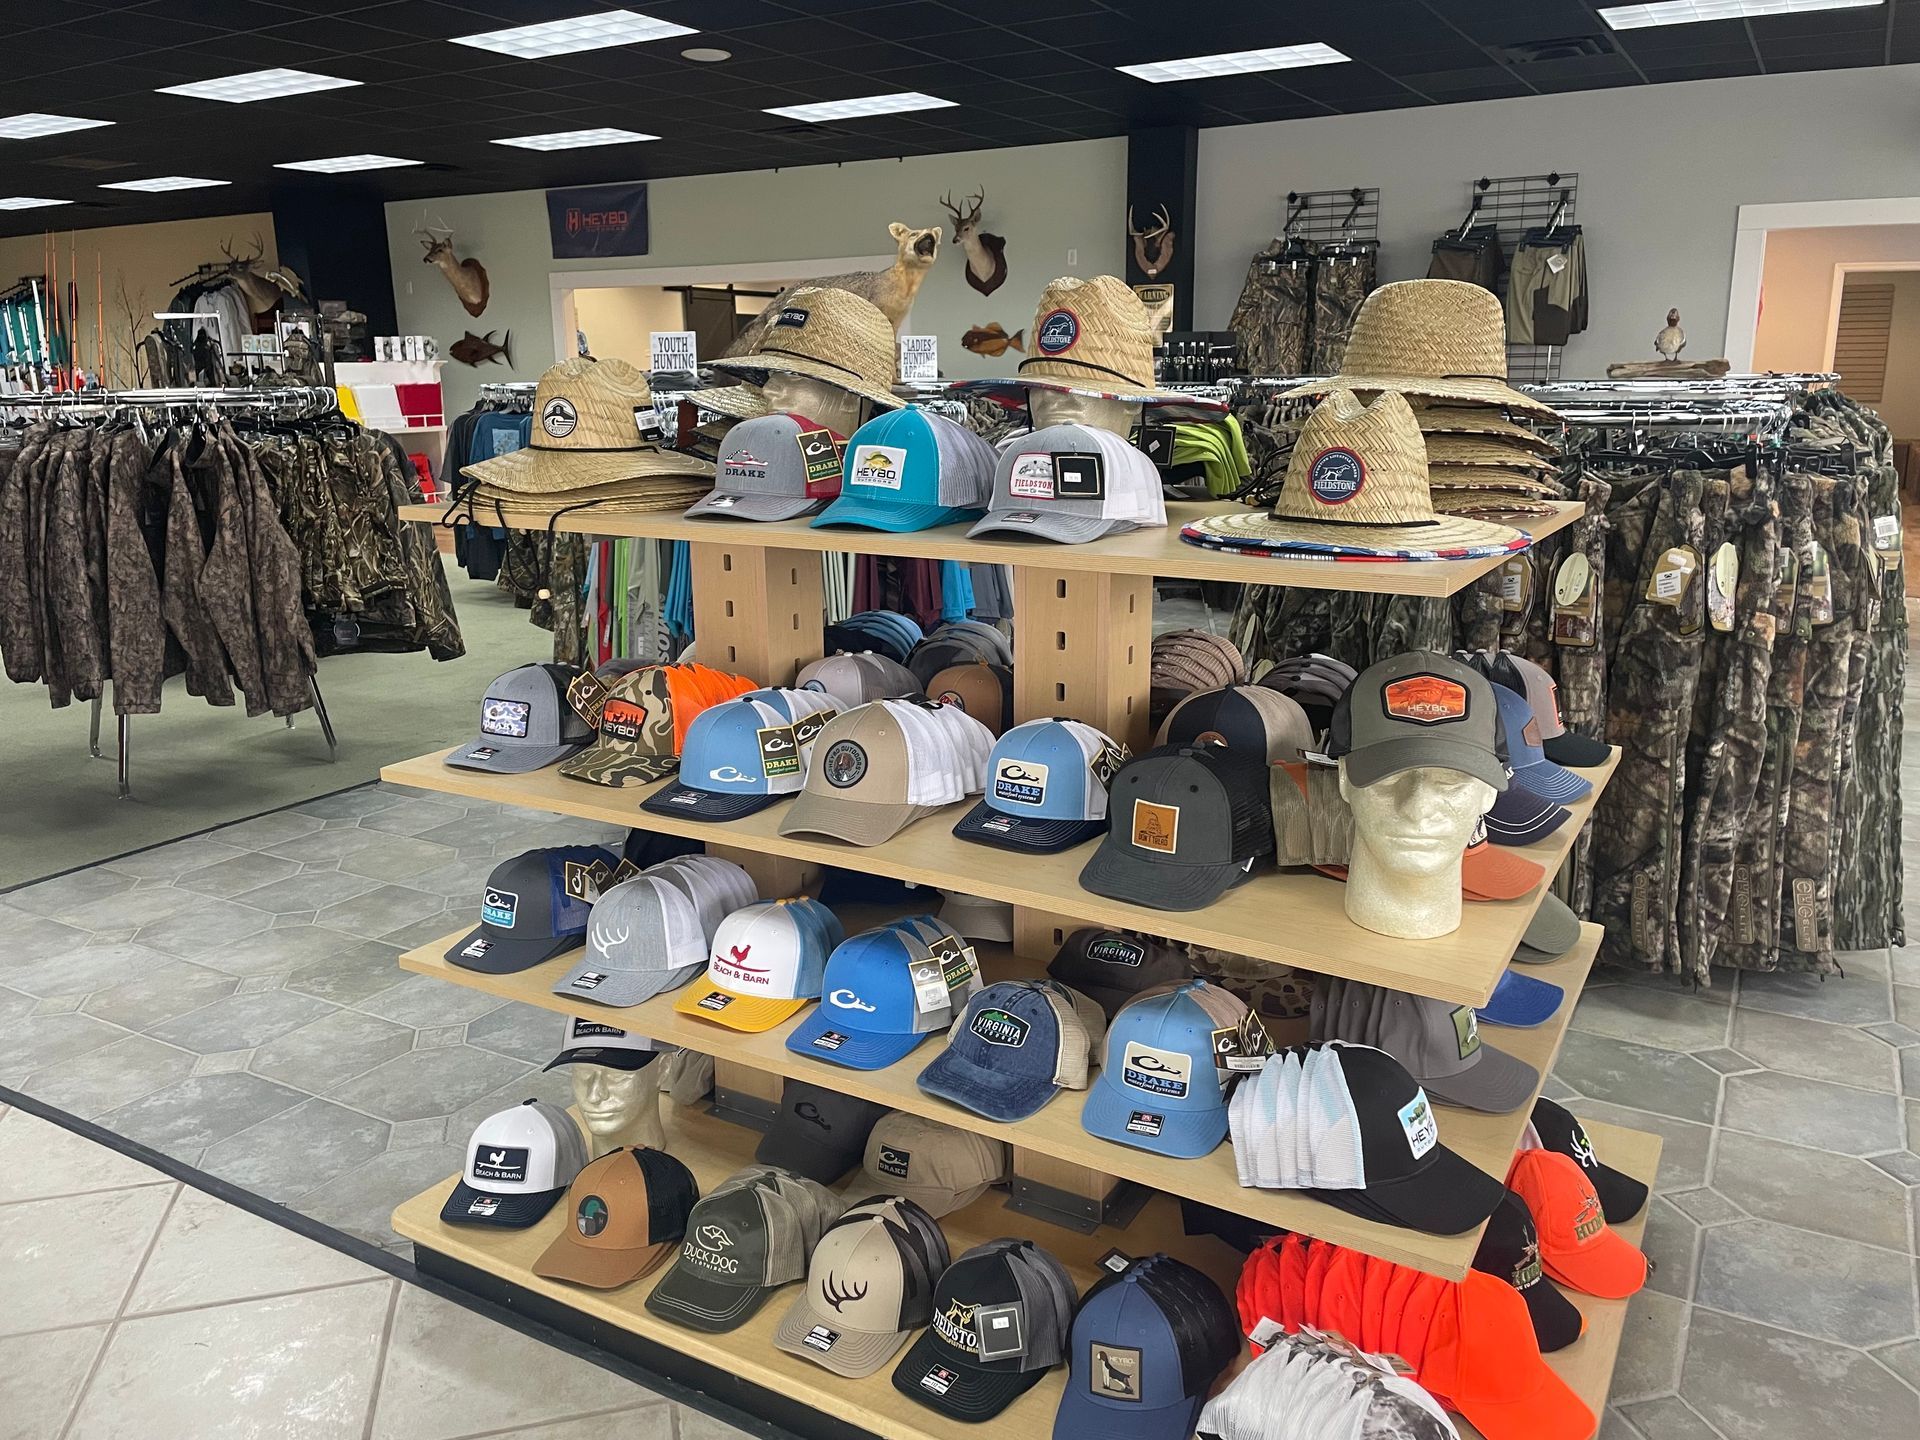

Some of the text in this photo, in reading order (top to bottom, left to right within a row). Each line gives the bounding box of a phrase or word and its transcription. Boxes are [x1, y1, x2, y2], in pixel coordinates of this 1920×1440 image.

[582, 211, 629, 226] HEYBO
[658, 336, 688, 353] YOUTH
[907, 339, 932, 351] LADIES
[653, 353, 694, 370] HUNTING
[903, 352, 935, 365] HUNTING
[725, 468, 766, 479] DRAKE
[809, 461, 840, 474] DRAKE
[856, 468, 896, 480] HEYBO
[1015, 479, 1055, 490] FIELDSTON
[1313, 480, 1357, 491] FIELDSTONE
[1407, 704, 1448, 713] HEYBO
[603, 722, 636, 738] HEYBO
[767, 759, 798, 770] DRAKE
[997, 781, 1040, 796] DRAKE
[1094, 946, 1137, 961] VIRGINIA
[713, 962, 770, 985] BEACH & BARN
[945, 964, 970, 982] DRAKE
[977, 1016, 1021, 1039] VIRGINIA
[1126, 1069, 1183, 1090] DRAKE
[475, 1168, 493, 1177] BEACH
[501, 1172, 522, 1180] BARN
[880, 1162, 907, 1176] DRAKE
[683, 1242, 739, 1274] DUCK DOG
[932, 1307, 979, 1348] FIELDSTO
